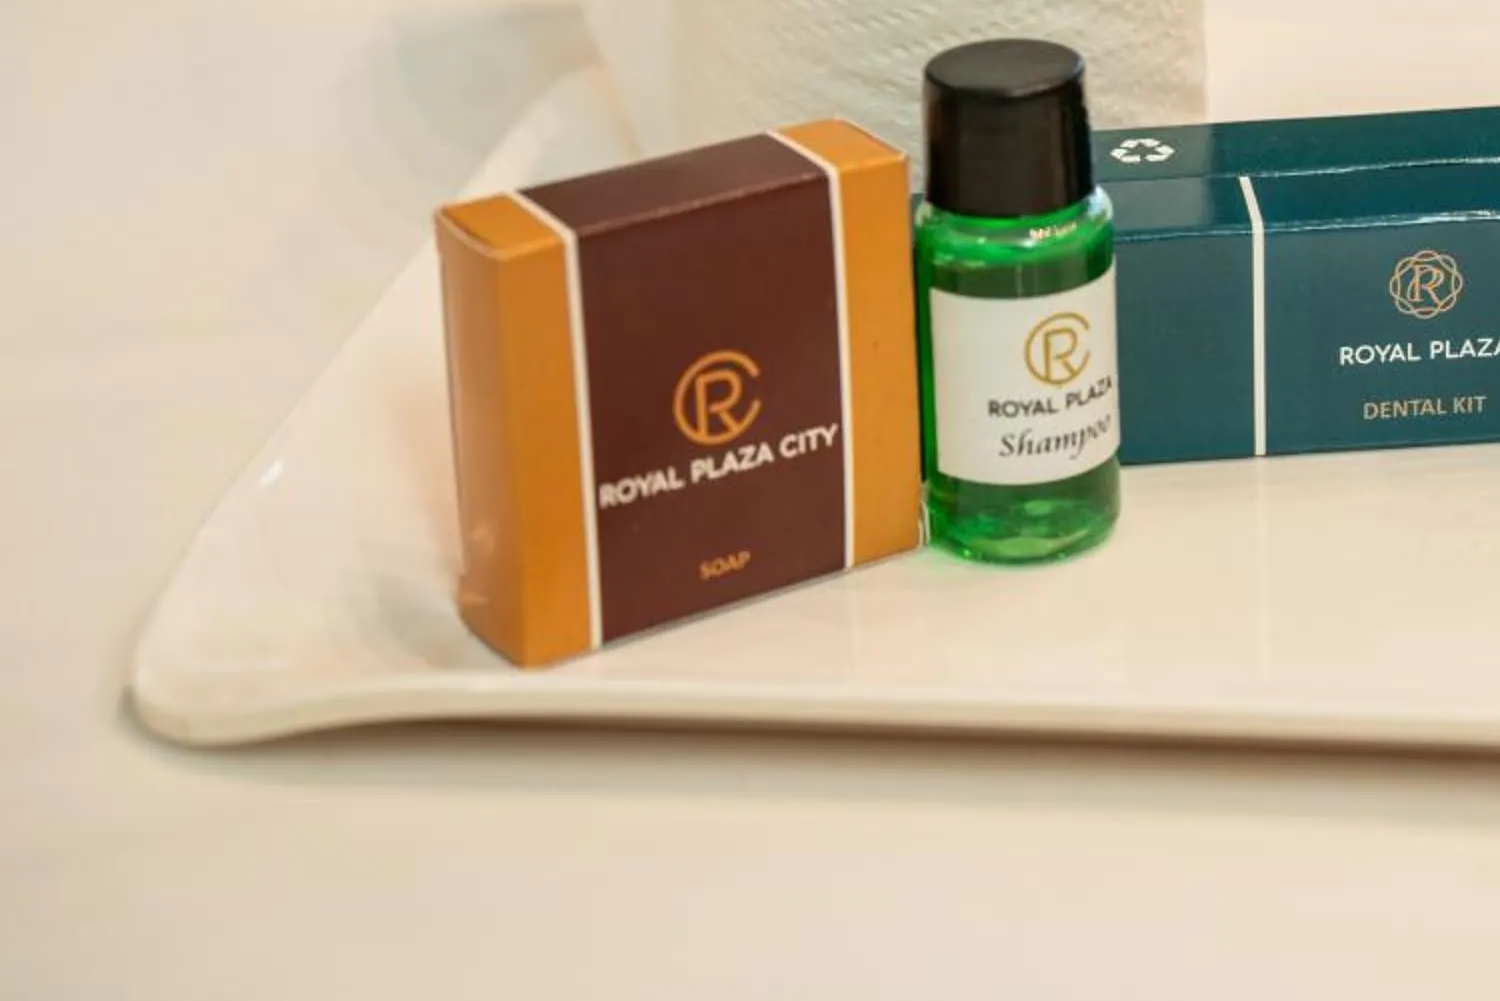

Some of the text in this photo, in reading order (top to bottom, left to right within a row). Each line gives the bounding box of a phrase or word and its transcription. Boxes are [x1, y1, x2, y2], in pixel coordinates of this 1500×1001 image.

[1339, 342, 1422, 366] ROYAL
[987, 399, 1059, 419] ROYAL
[1363, 395, 1488, 421] DENTAL KIT
[599, 422, 839, 510] ROYAL PLAZA CITY
[699, 550, 752, 581] SOAP
